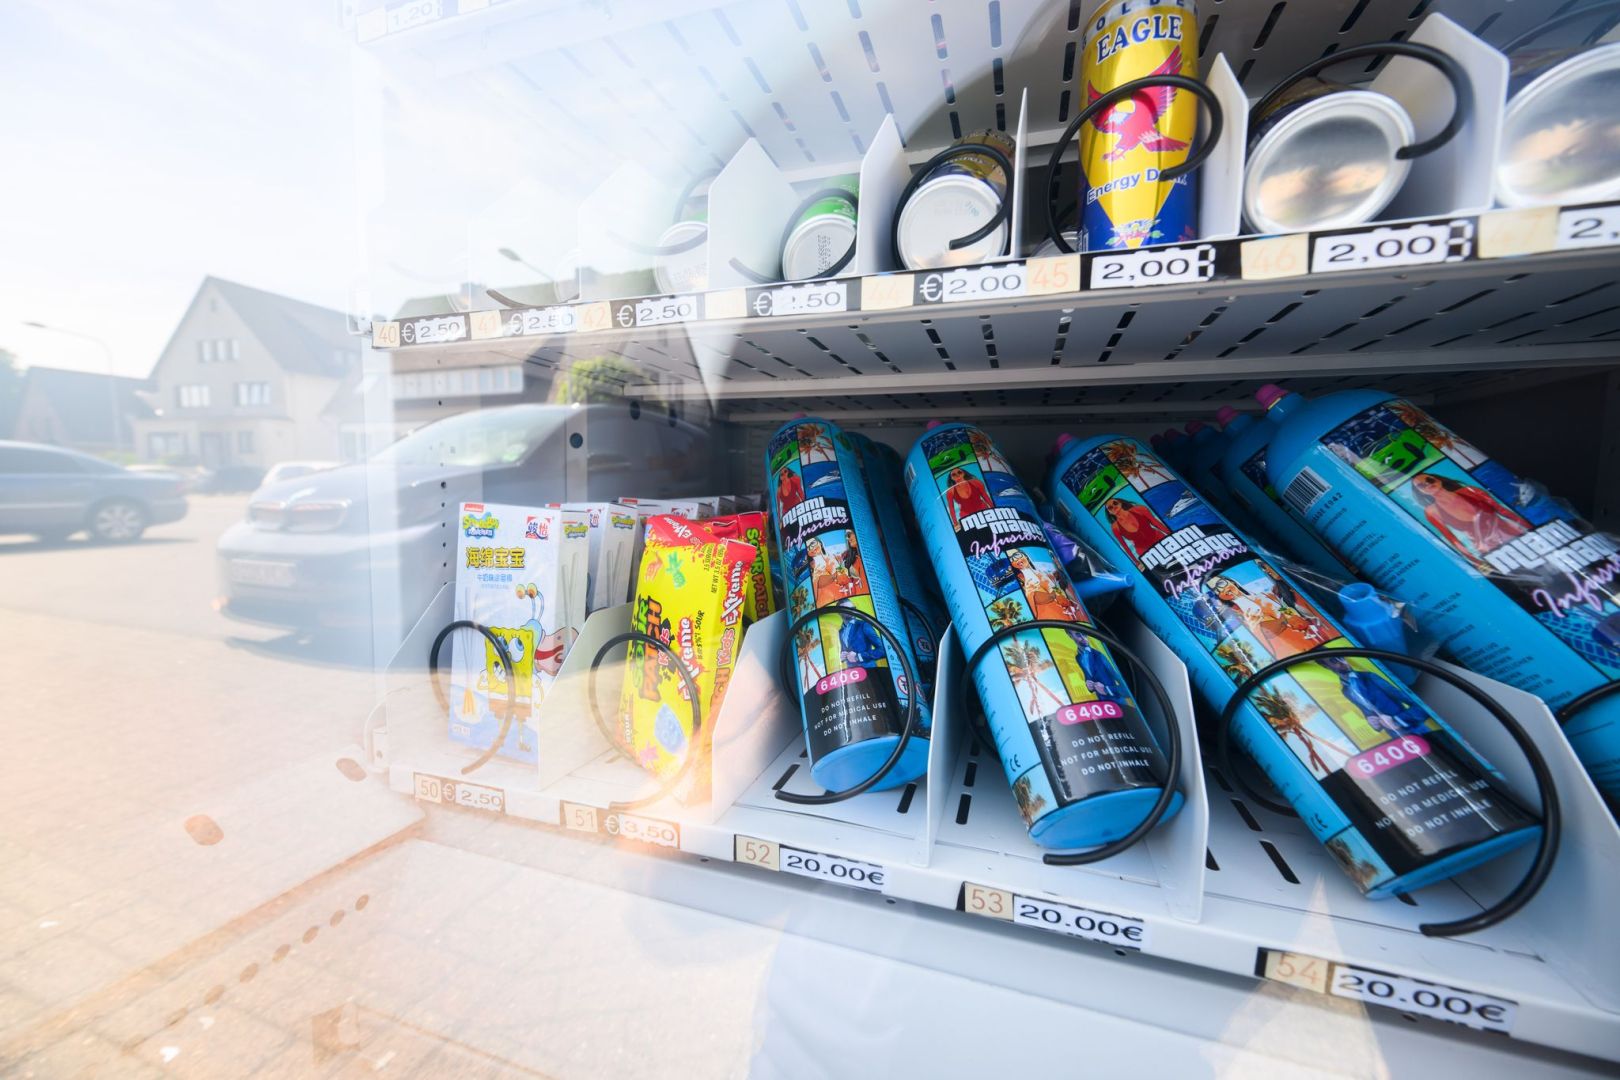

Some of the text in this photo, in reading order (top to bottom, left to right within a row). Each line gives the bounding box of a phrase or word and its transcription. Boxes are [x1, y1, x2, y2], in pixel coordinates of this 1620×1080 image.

[1097, 15, 1183, 63] EAGLE
[1087, 173, 1140, 205] Energy
[1032, 257, 1069, 288] 45
[639, 302, 692, 323] 2.50
[378, 325, 397, 344] 40
[465, 546, 526, 570] 海绵宝宝
[819, 669, 861, 692] 640G
[821, 704, 830, 714] DO
[847, 692, 871, 703] REFILL
[825, 712, 837, 723] FOR
[872, 702, 888, 711] USE
[1064, 703, 1117, 722] 640G
[823, 726, 832, 737] DO
[848, 714, 878, 726] INHALE
[1071, 732, 1136, 748] DO NOT REFILL
[1060, 755, 1078, 767] NOT
[1081, 750, 1100, 761] FOR
[1101, 746, 1139, 756] MEDICAL
[1081, 759, 1150, 776] DO NOT INHALE
[1356, 738, 1422, 775] 640G
[419, 779, 438, 798] 50
[461, 788, 502, 807] 2.50
[1380, 792, 1398, 806] DO
[1398, 782, 1421, 797] NOT
[1421, 786, 1471, 809] MEDICAL
[574, 810, 595, 829] 51
[1406, 824, 1425, 838] DO
[1424, 813, 1450, 830] NOT
[745, 841, 770, 865] 52
[786, 854, 885, 886] 20.00€
[972, 887, 1003, 914] 53
[1019, 903, 1144, 943] 20.00€
[1275, 951, 1318, 985] 54
[1338, 974, 1506, 1024] 20.00€
